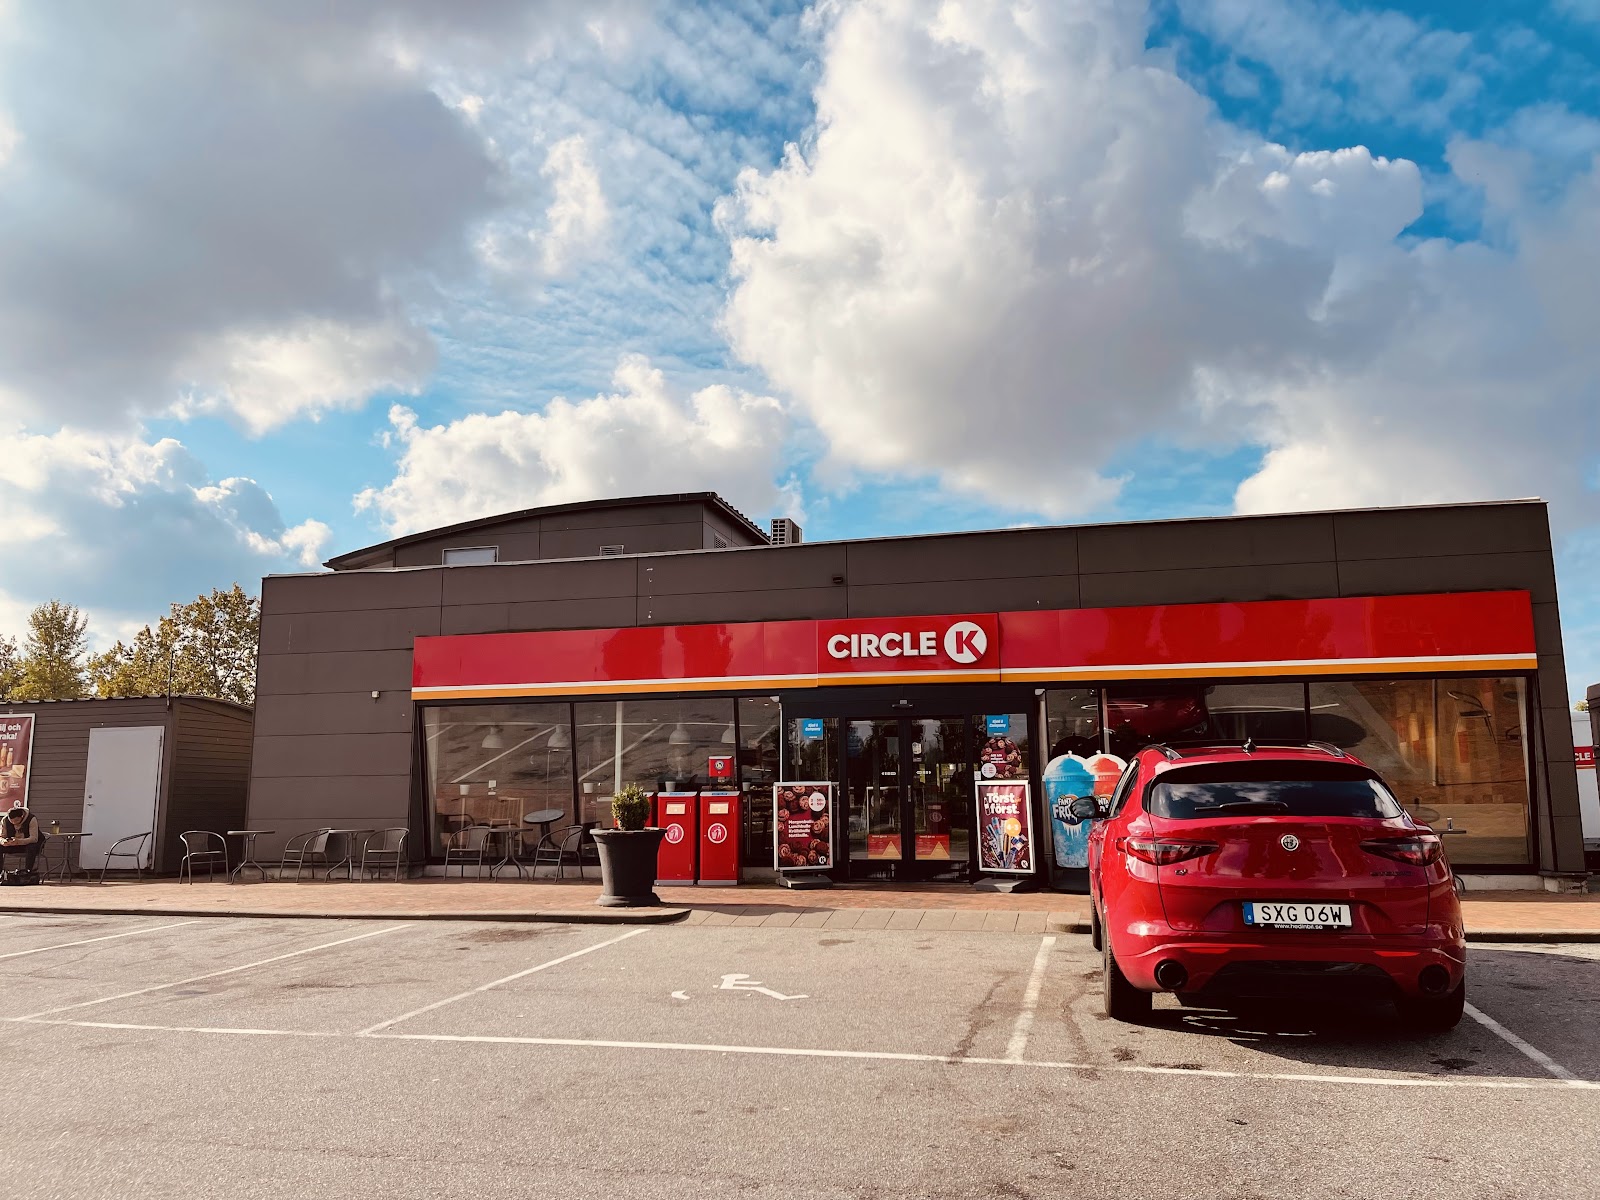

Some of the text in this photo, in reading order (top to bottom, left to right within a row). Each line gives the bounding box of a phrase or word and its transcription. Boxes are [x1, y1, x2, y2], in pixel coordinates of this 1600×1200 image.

[827, 630, 984, 661] CIRCLE K
[7, 723, 21, 731] och
[986, 792, 1015, 804] Törst
[990, 802, 1020, 815] först.
[1261, 905, 1298, 922] SXG
[1304, 906, 1342, 923] 06W
